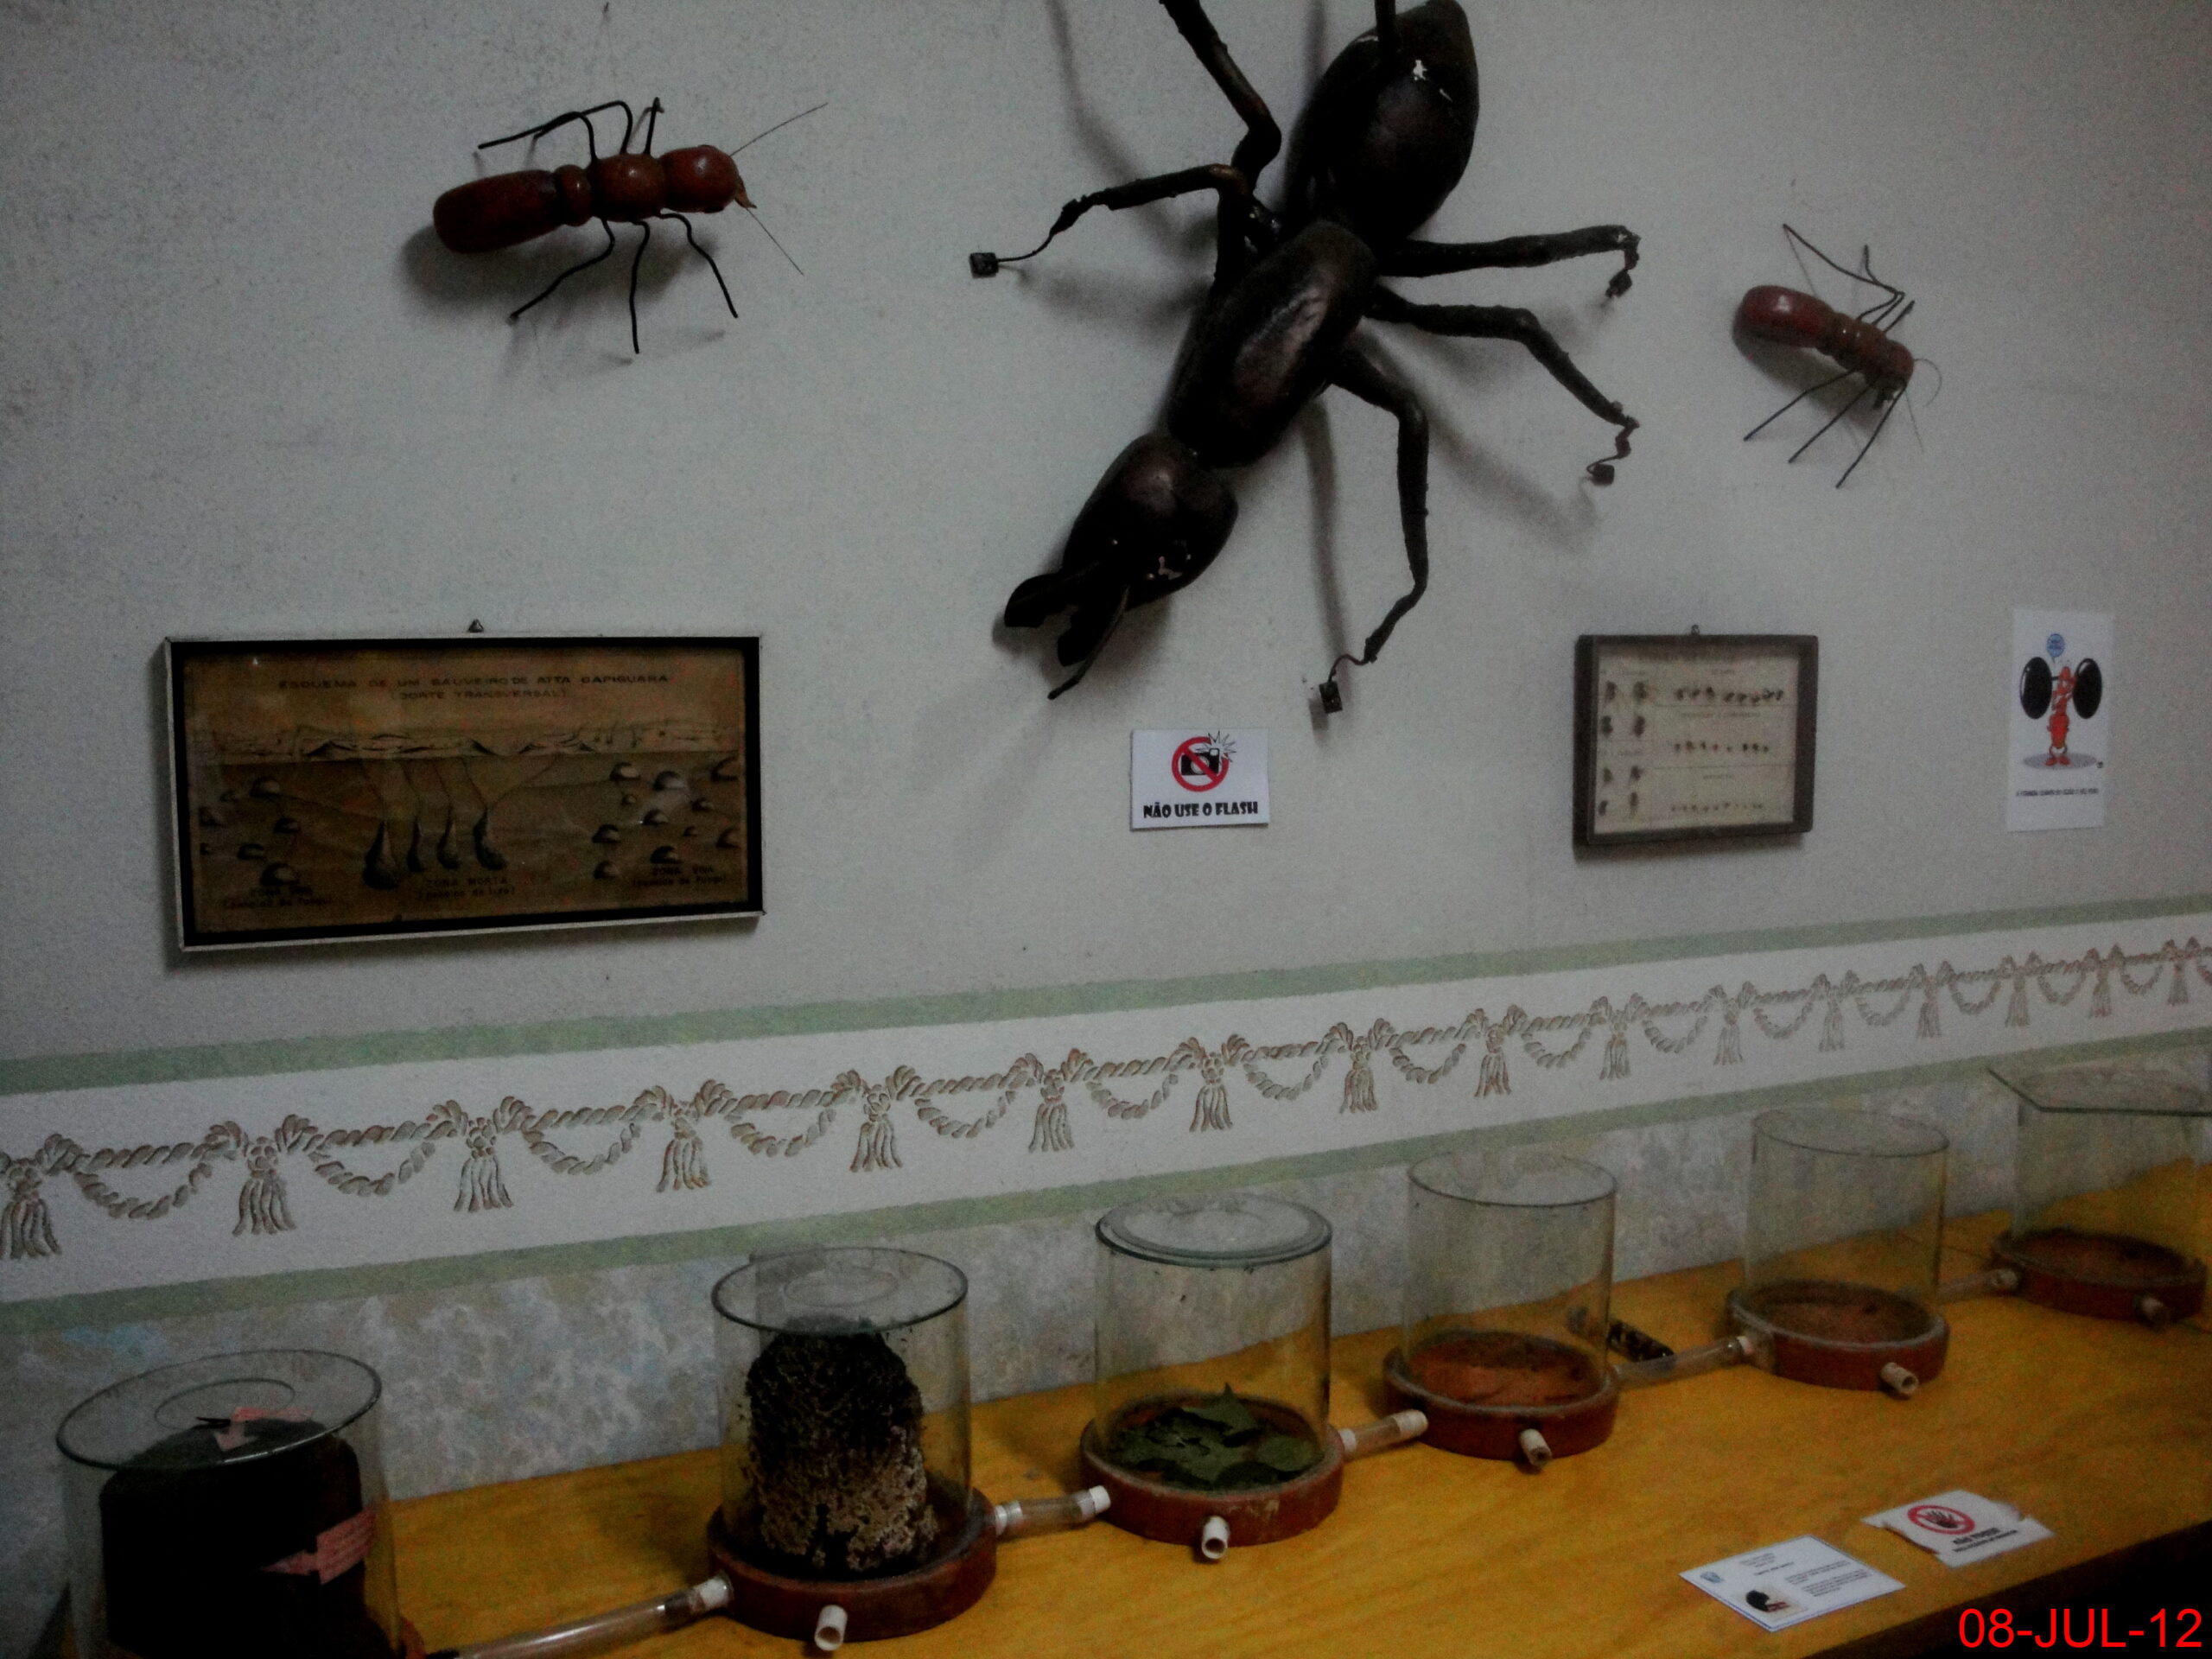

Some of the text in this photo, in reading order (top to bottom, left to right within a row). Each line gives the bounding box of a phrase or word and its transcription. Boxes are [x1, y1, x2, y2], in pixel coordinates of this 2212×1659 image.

[278, 679, 357, 689] ESQUEMA
[368, 679, 386, 688] DE
[1143, 801, 1258, 818] NÃO USE O FLASH
